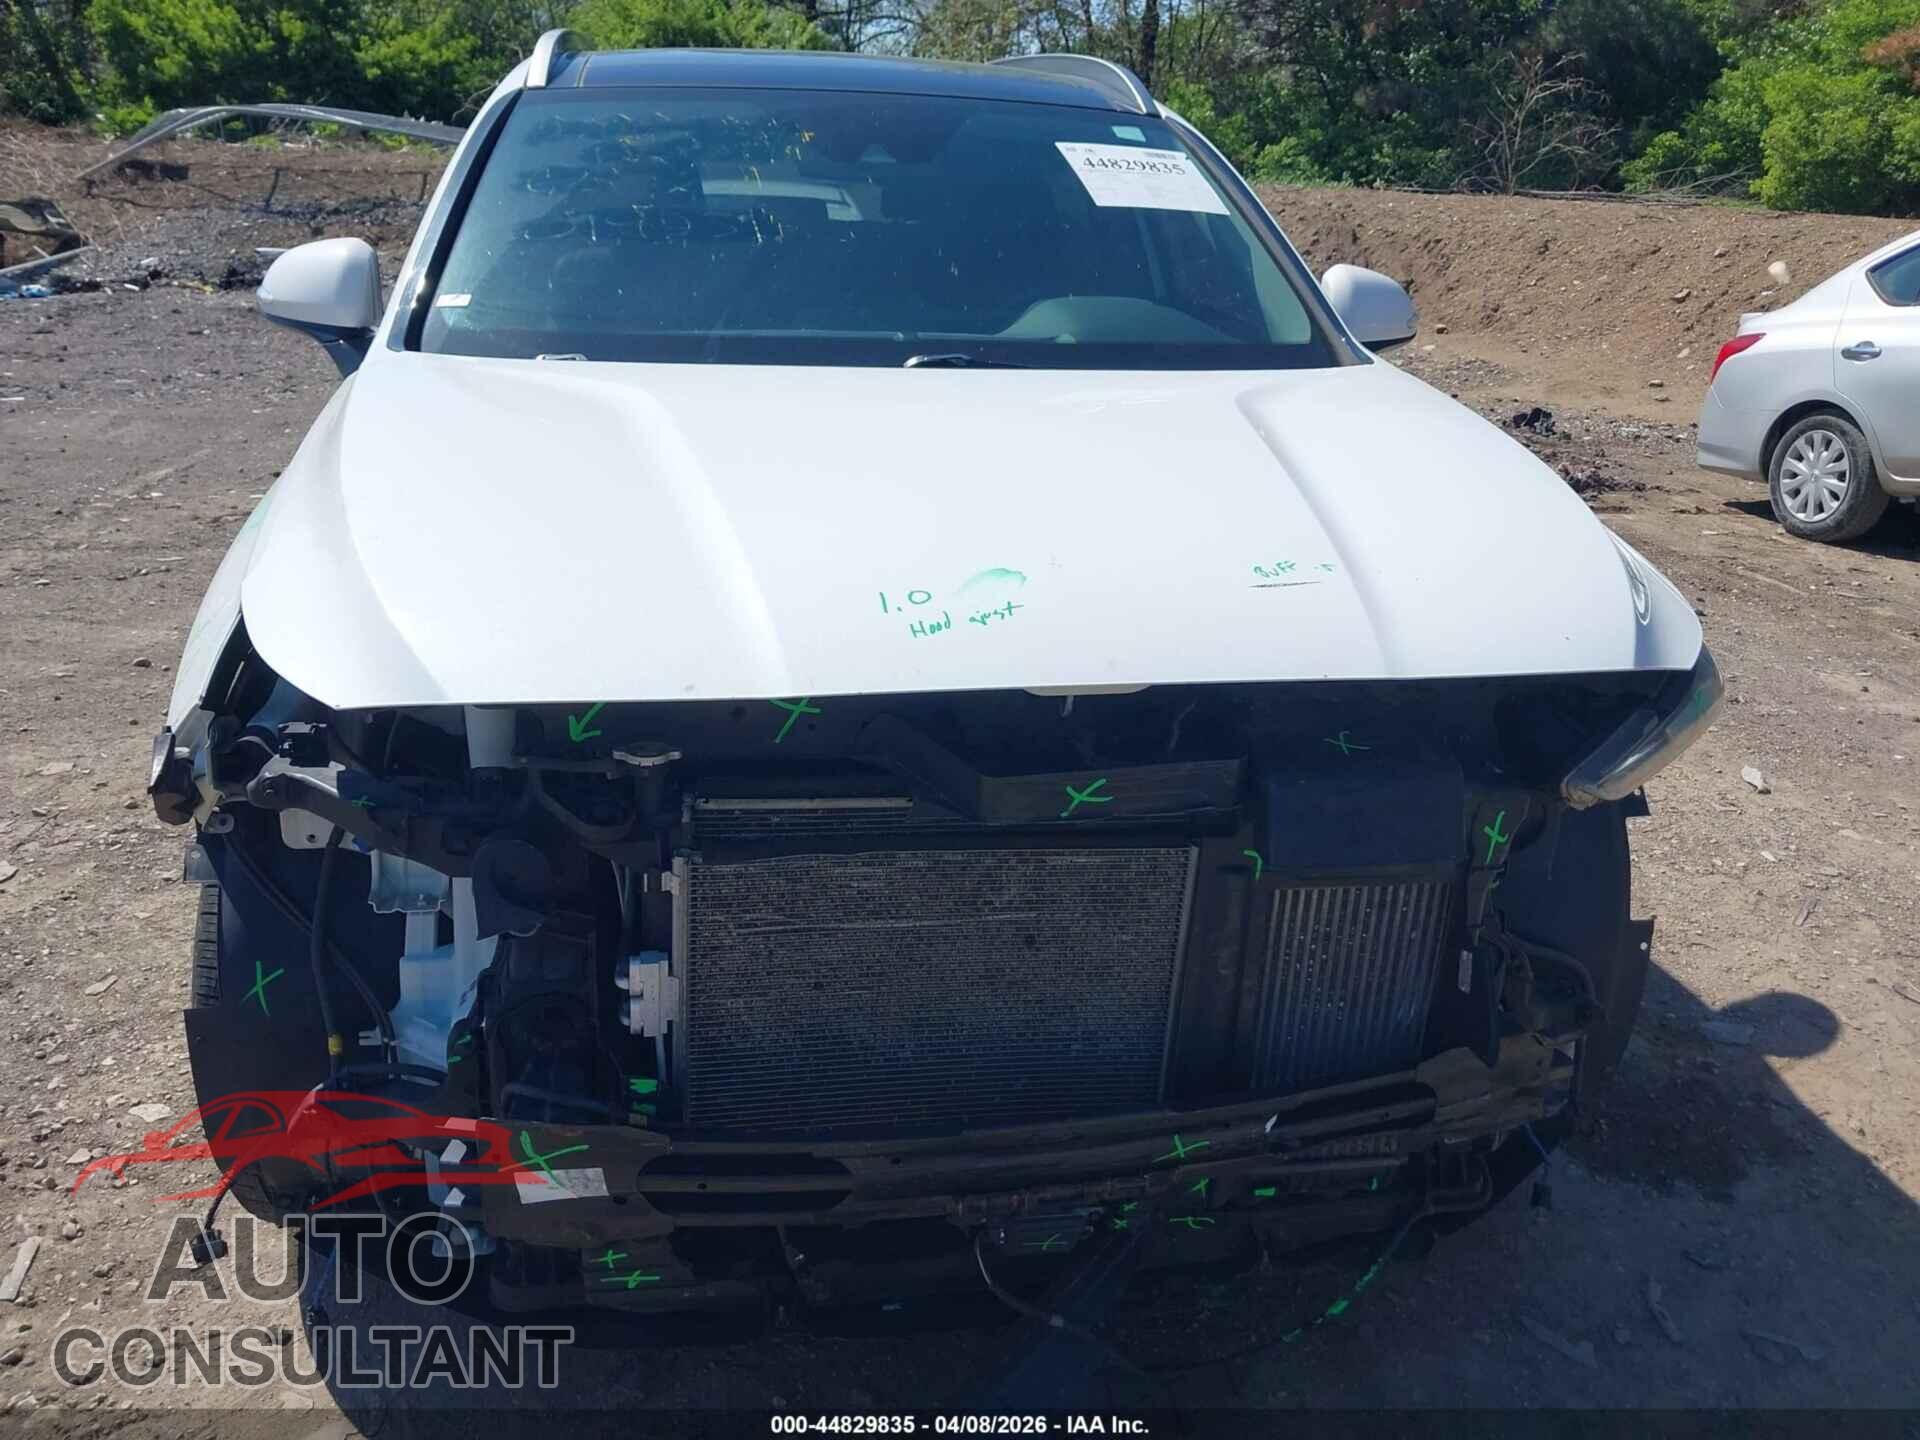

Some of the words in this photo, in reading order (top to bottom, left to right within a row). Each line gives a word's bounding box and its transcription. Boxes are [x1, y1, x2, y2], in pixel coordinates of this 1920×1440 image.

[1083, 156, 1187, 176] 44829835
[879, 590, 932, 614] 1.0
[909, 610, 952, 639] Hood
